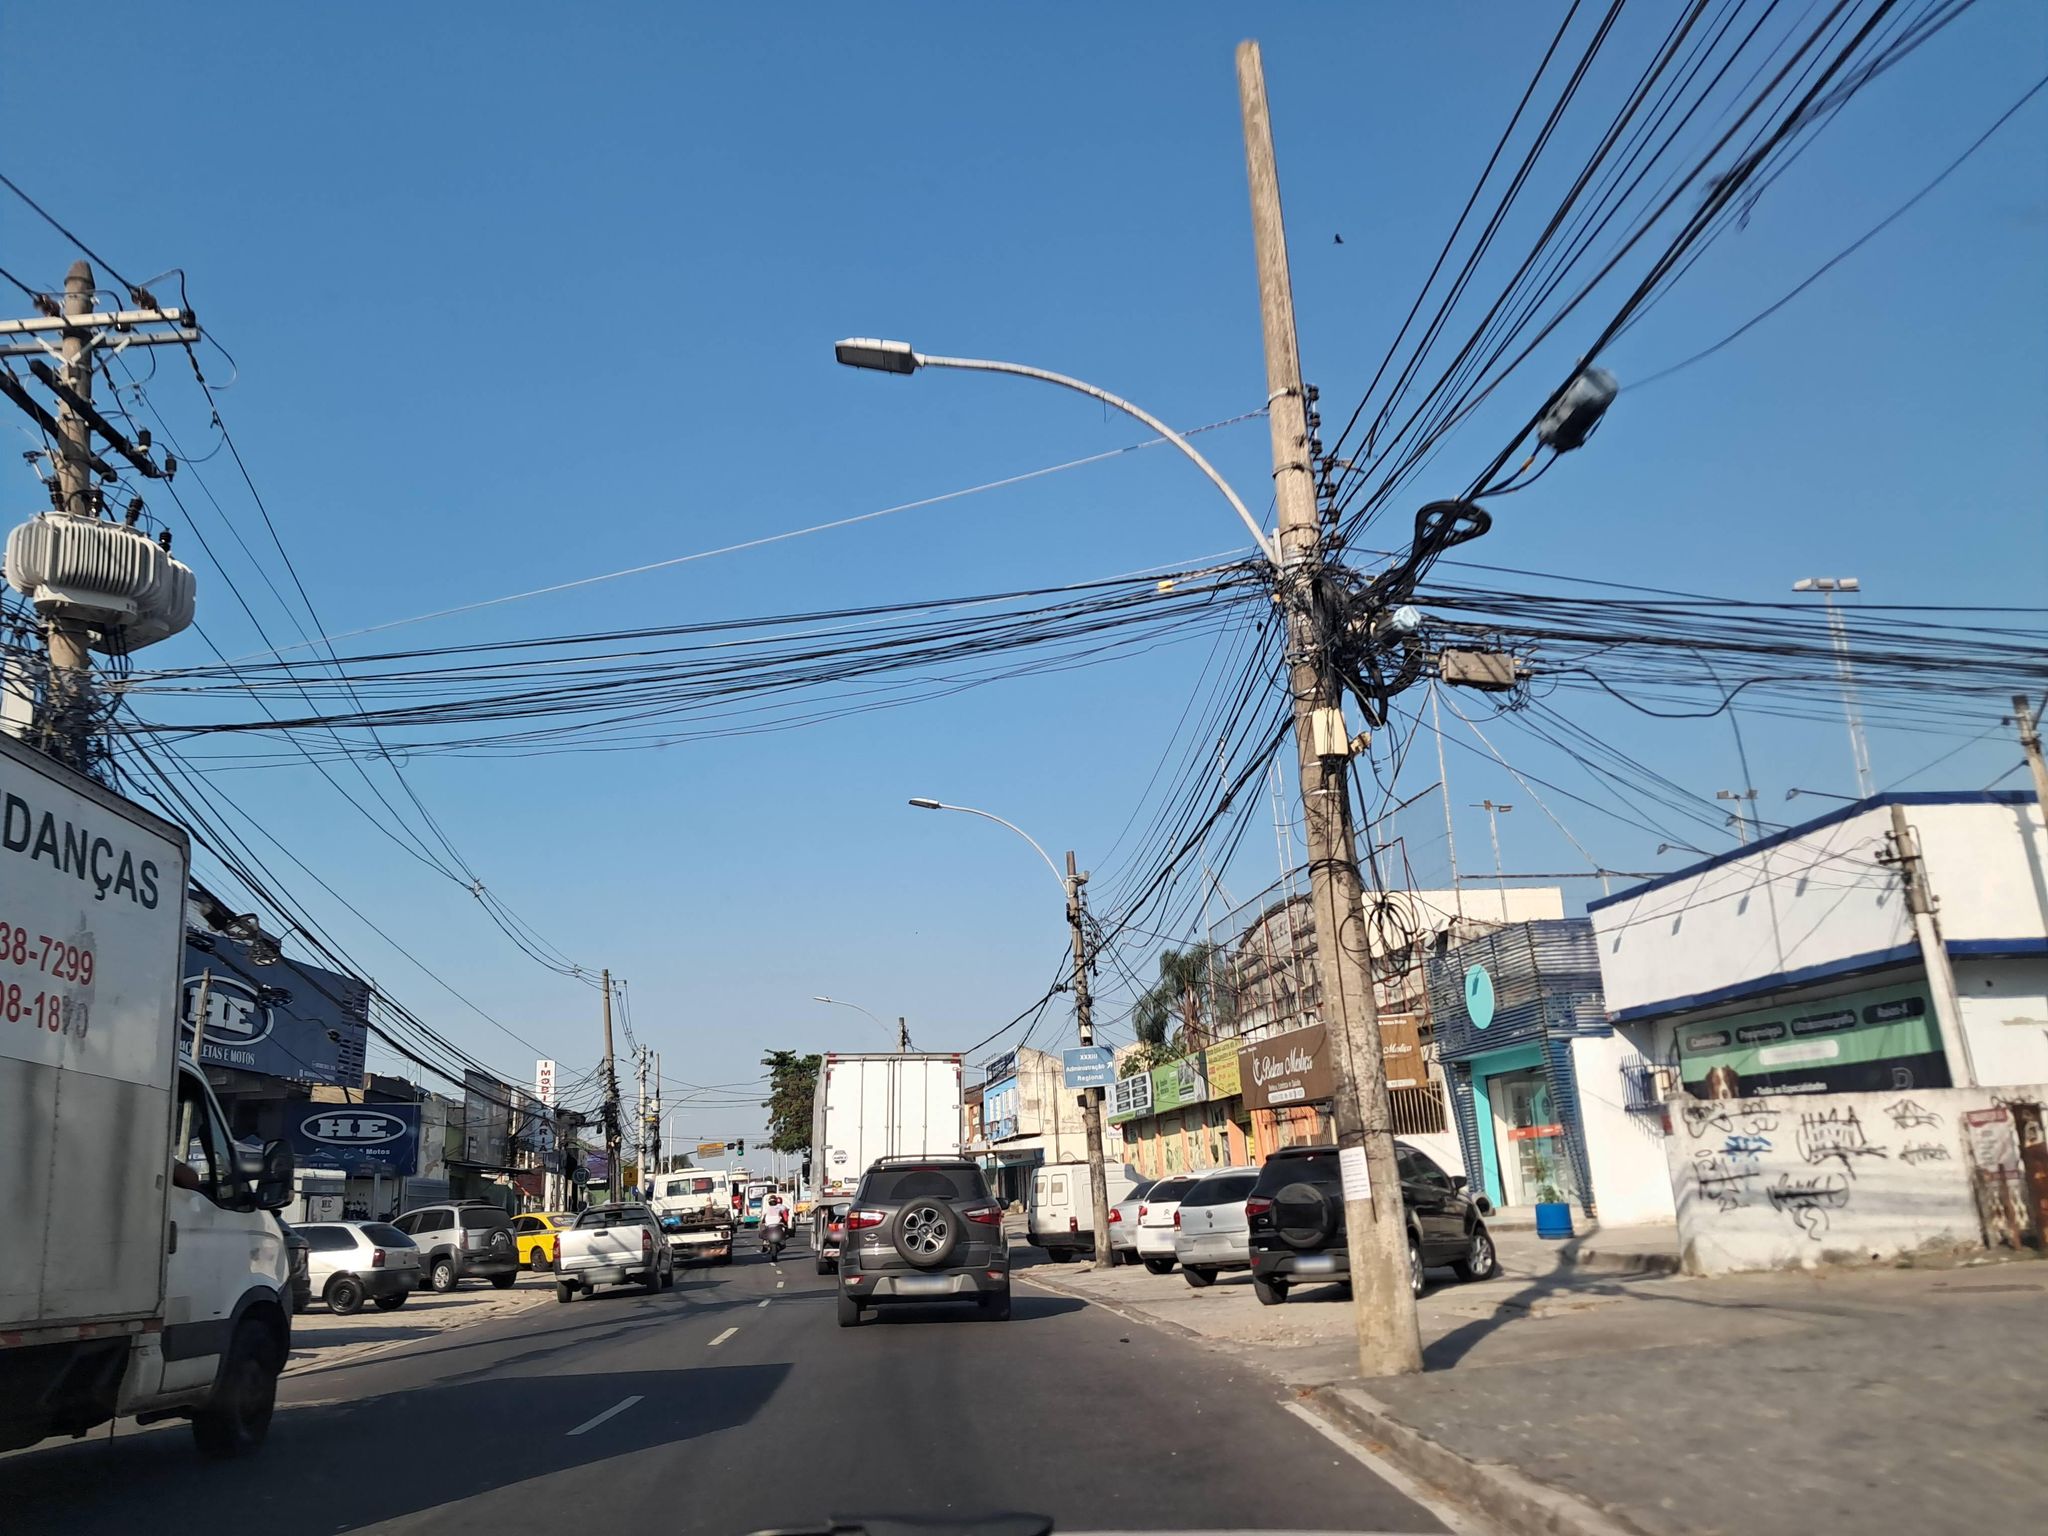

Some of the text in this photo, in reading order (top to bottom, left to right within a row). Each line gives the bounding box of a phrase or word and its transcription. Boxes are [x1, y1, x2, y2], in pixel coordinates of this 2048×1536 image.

[230, 1050, 255, 1065] MOTOS
[1077, 1074, 1104, 1082] Regional
[366, 1148, 391, 1156] Motos
